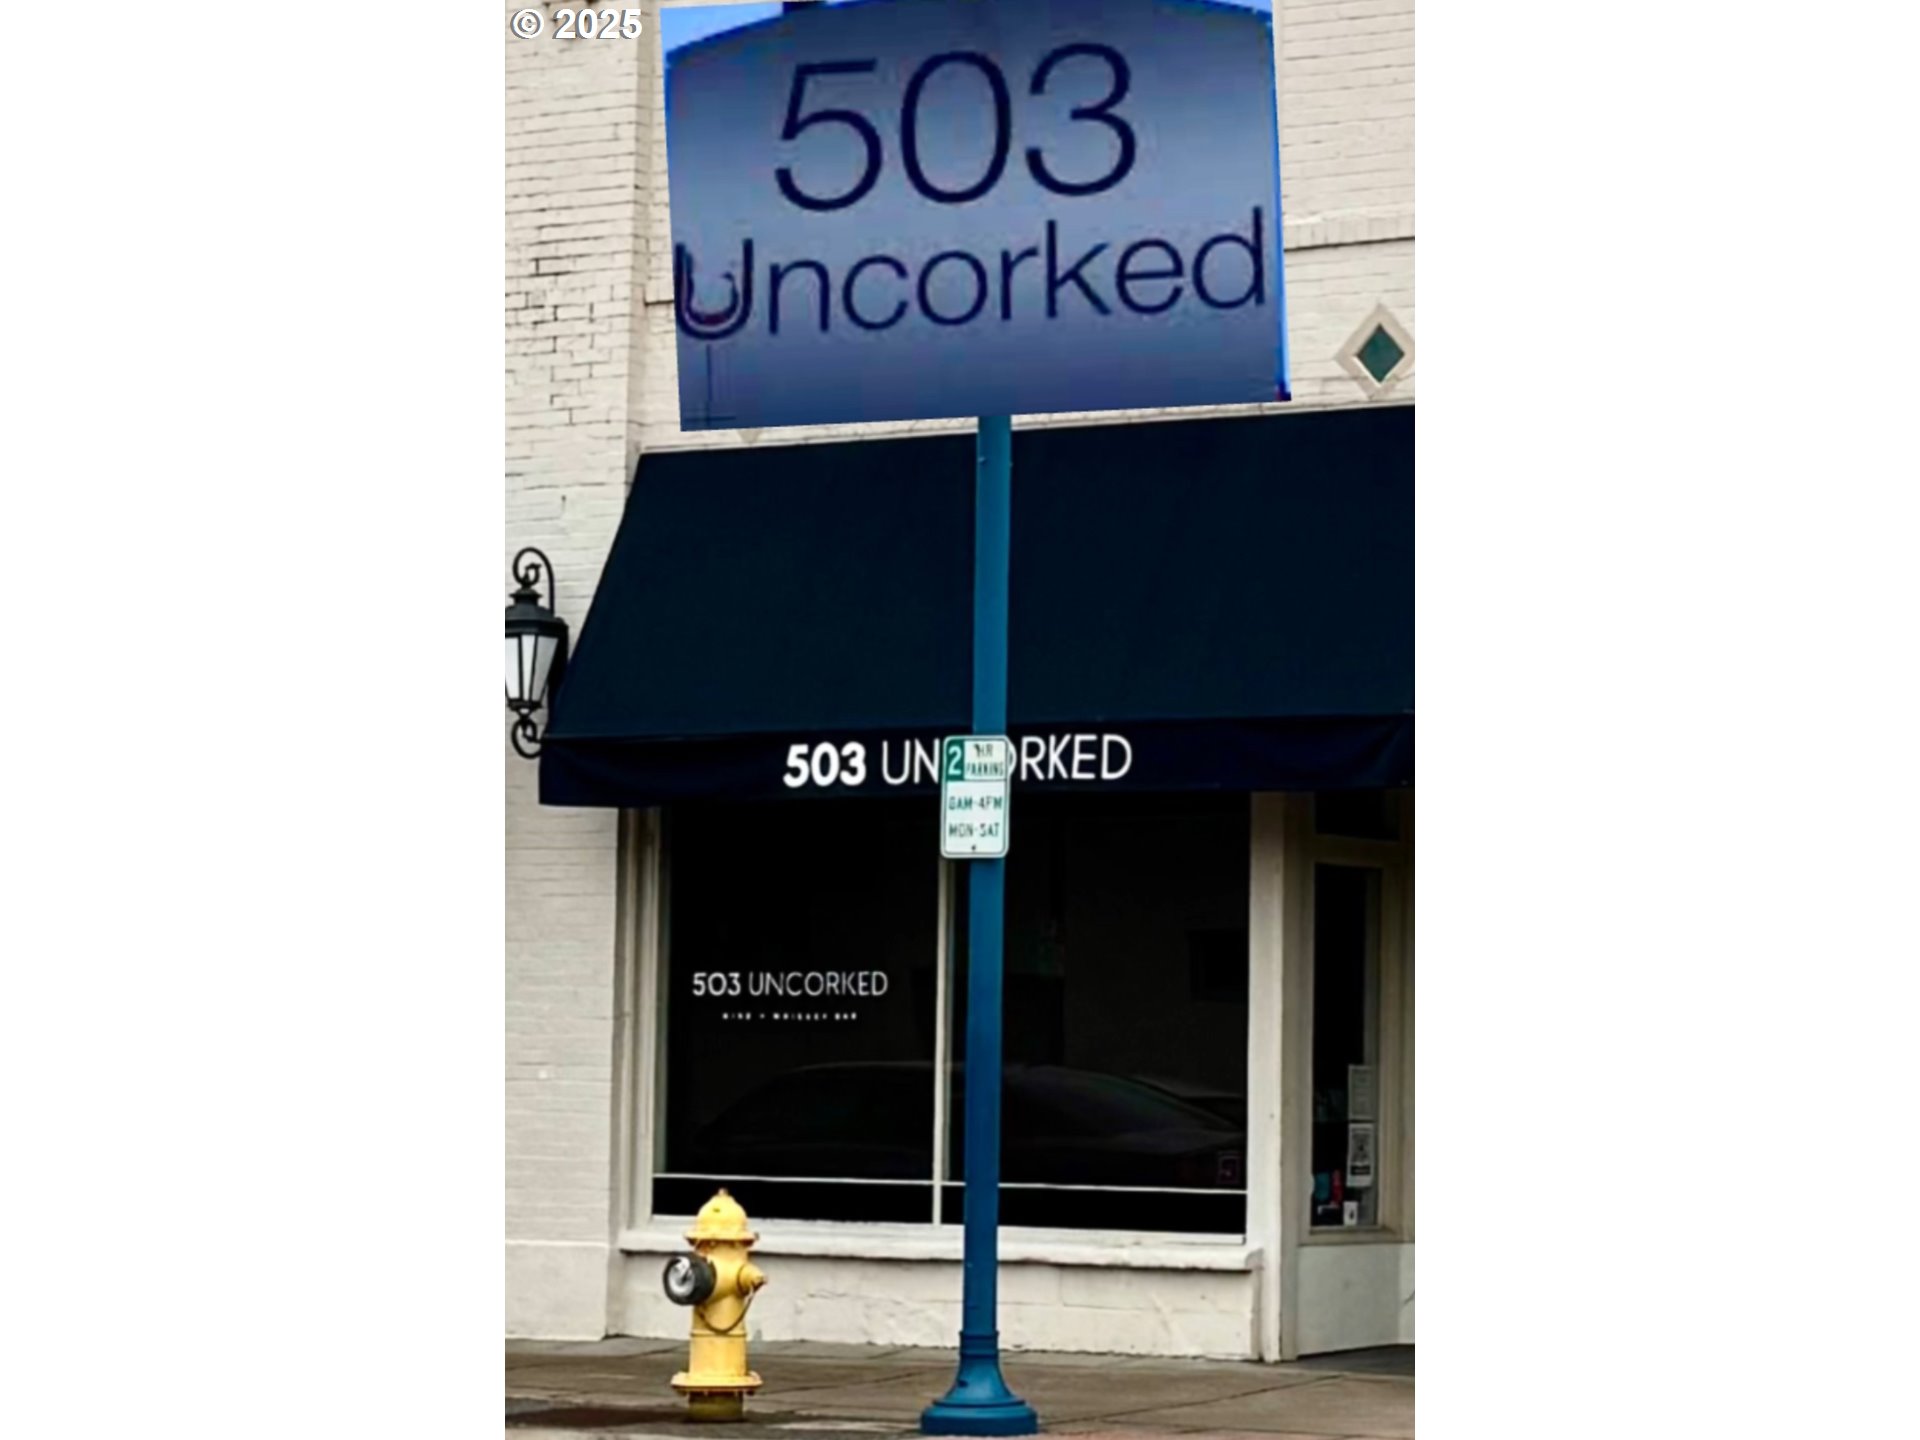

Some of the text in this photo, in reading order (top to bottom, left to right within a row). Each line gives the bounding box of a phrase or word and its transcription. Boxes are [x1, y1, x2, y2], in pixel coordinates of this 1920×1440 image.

[775, 42, 1137, 212] 503
[674, 206, 1266, 342] Uncorked
[783, 734, 1132, 787] 503 UNRKED
[948, 745, 962, 775] 2
[966, 762, 1004, 776] PARKING
[692, 971, 888, 996] 503 UNCORKED
